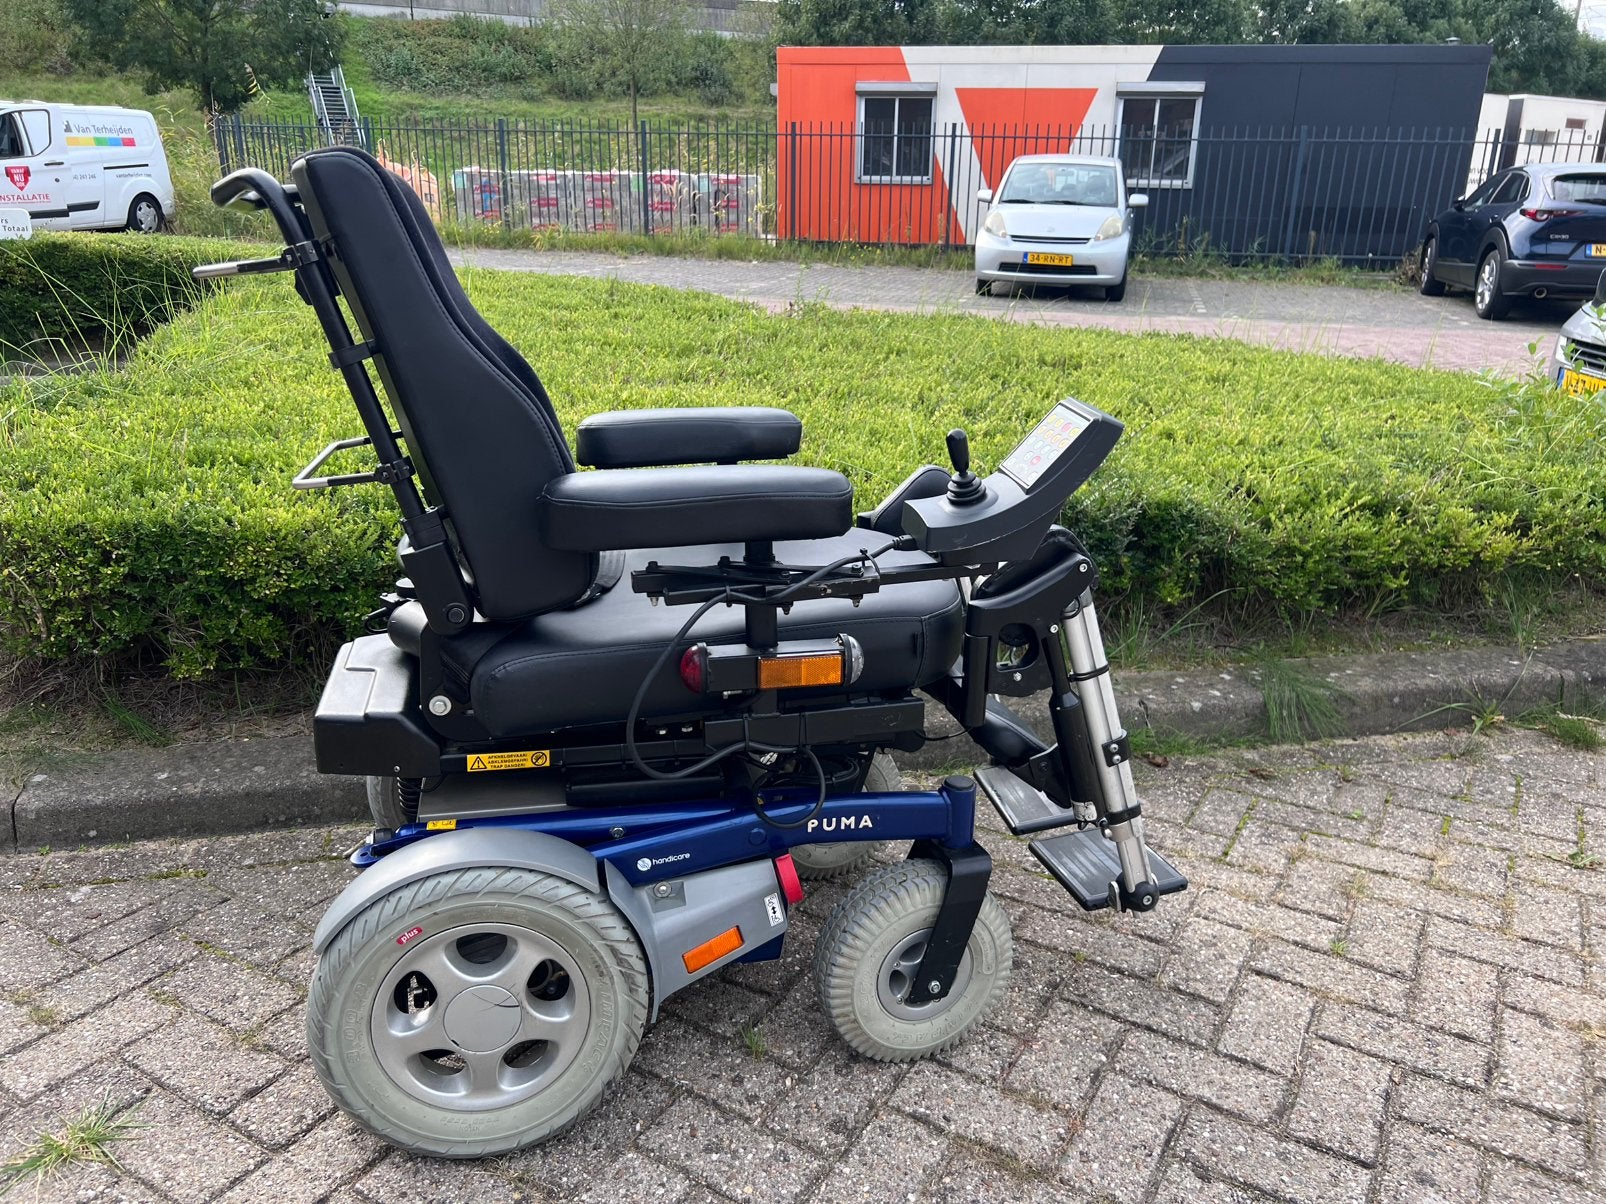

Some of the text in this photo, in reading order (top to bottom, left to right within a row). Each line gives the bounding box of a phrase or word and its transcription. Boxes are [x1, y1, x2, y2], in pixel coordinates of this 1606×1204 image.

[74, 124, 133, 136] Van Terheijden
[13, 173, 25, 182] NU
[1029, 254, 1070, 265] 34-RN-RT
[806, 814, 874, 834] PUMA
[652, 852, 691, 866] handicare
[400, 929, 420, 944] plus
